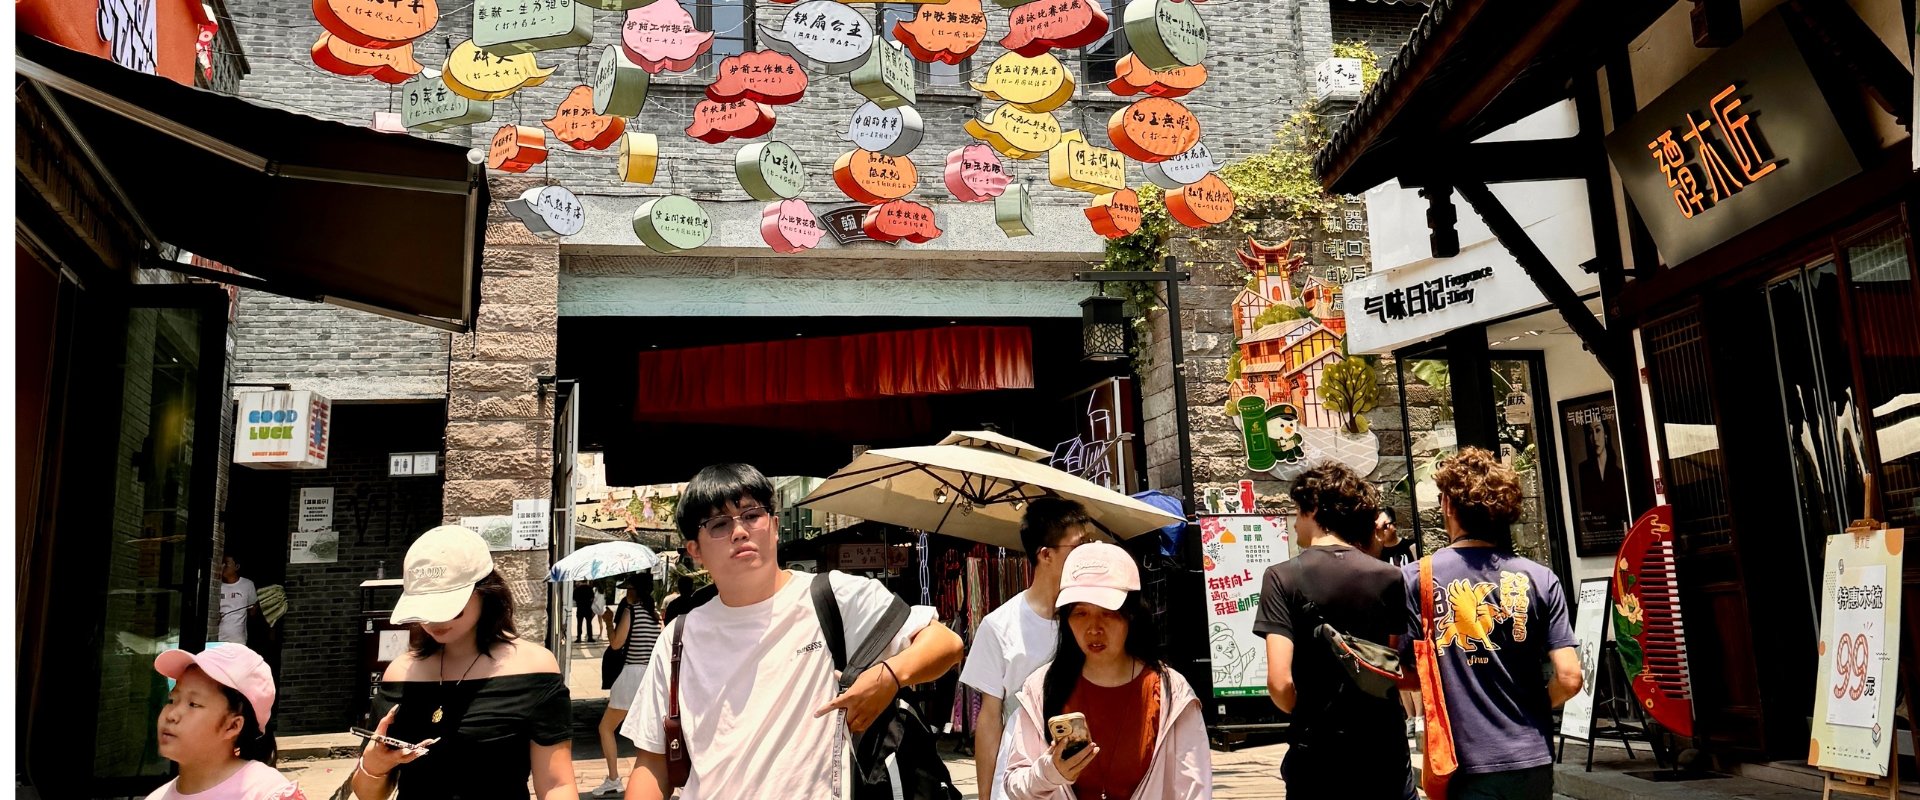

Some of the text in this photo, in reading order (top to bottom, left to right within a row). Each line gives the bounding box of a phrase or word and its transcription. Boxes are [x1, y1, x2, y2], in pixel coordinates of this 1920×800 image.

[793, 12, 863, 38] 铁扇公主
[1445, 266, 1494, 288] Fragrance
[1364, 277, 1447, 324] 气味日记
[1446, 289, 1475, 305] Diary
[248, 409, 298, 424] GOOD
[1567, 407, 1600, 426] 气味日记
[249, 426, 293, 440] LUCK
[1208, 569, 1254, 590] 右转向上
[1210, 591, 1229, 601] 遇见
[1214, 593, 1260, 616] 奇趣邮局
[1837, 585, 1883, 610] 特惠木梳
